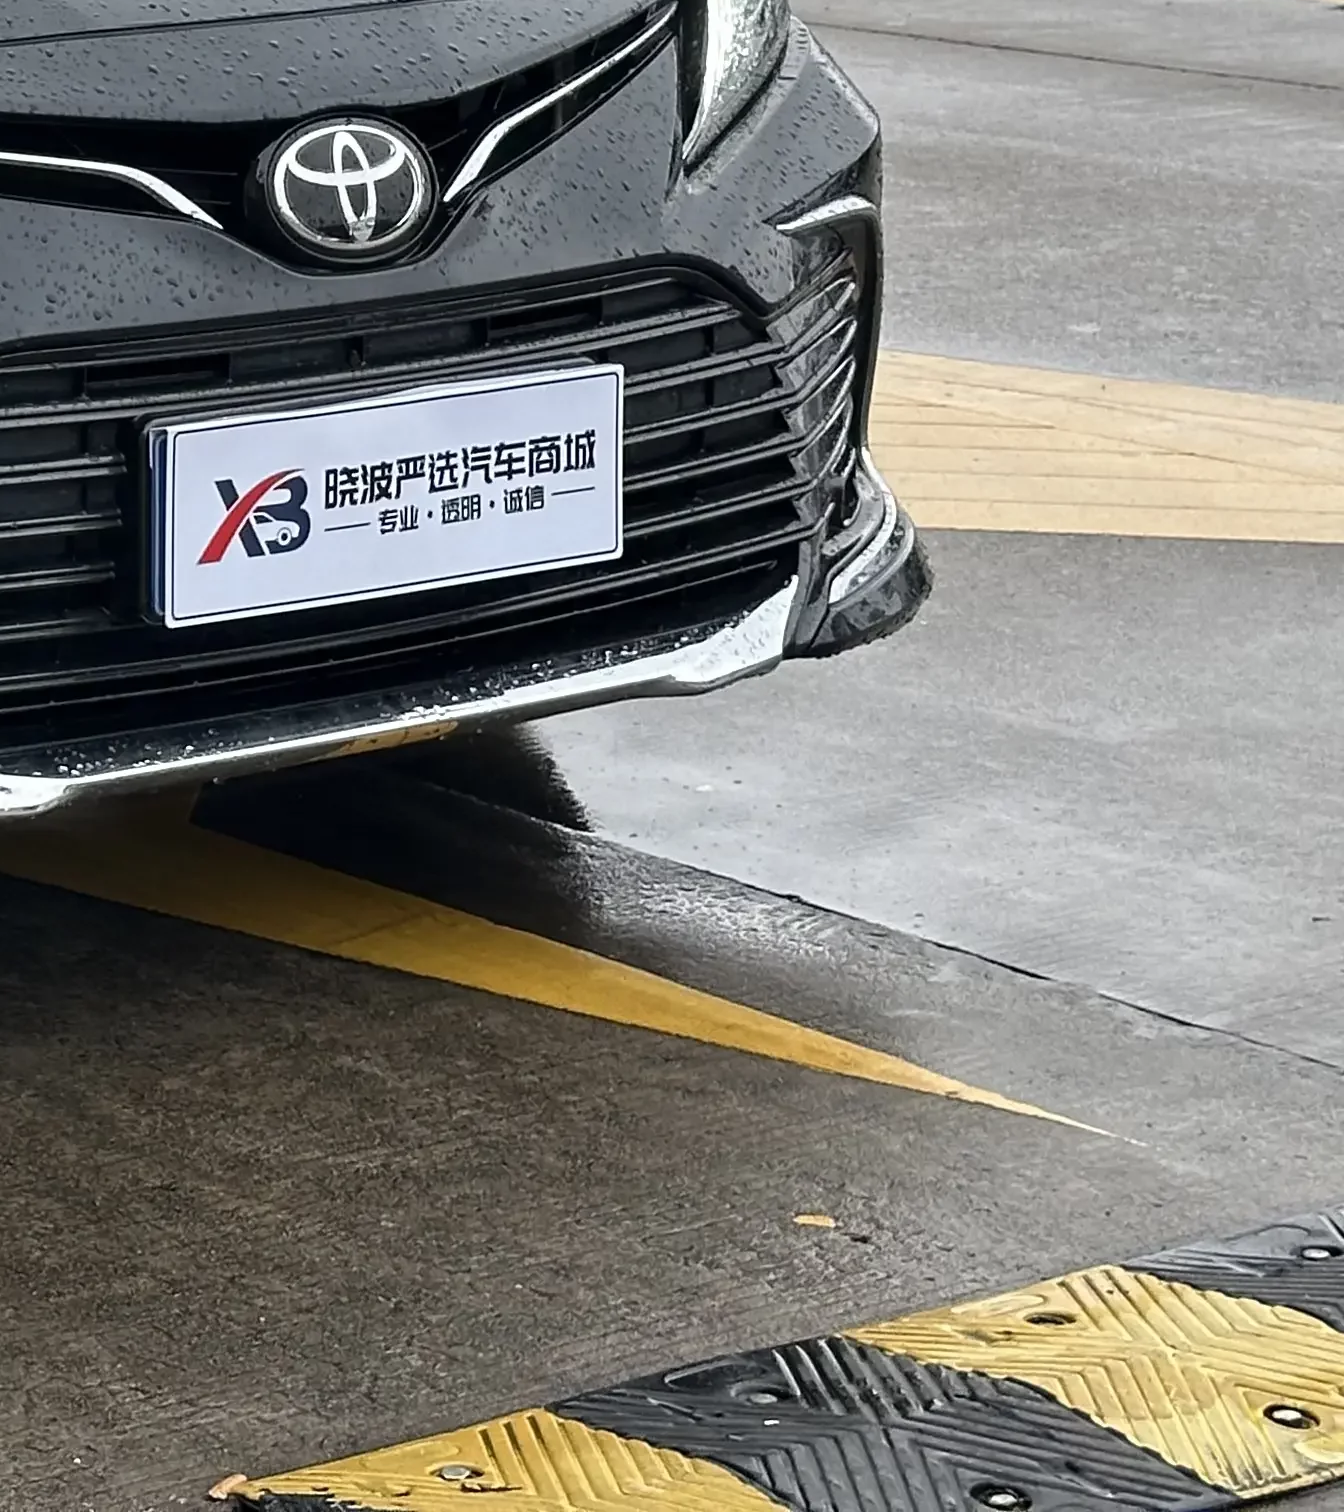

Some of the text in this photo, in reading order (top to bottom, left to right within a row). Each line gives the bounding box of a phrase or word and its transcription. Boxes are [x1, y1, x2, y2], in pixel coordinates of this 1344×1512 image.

[324, 429, 597, 509] 晓波严选汽车商城
